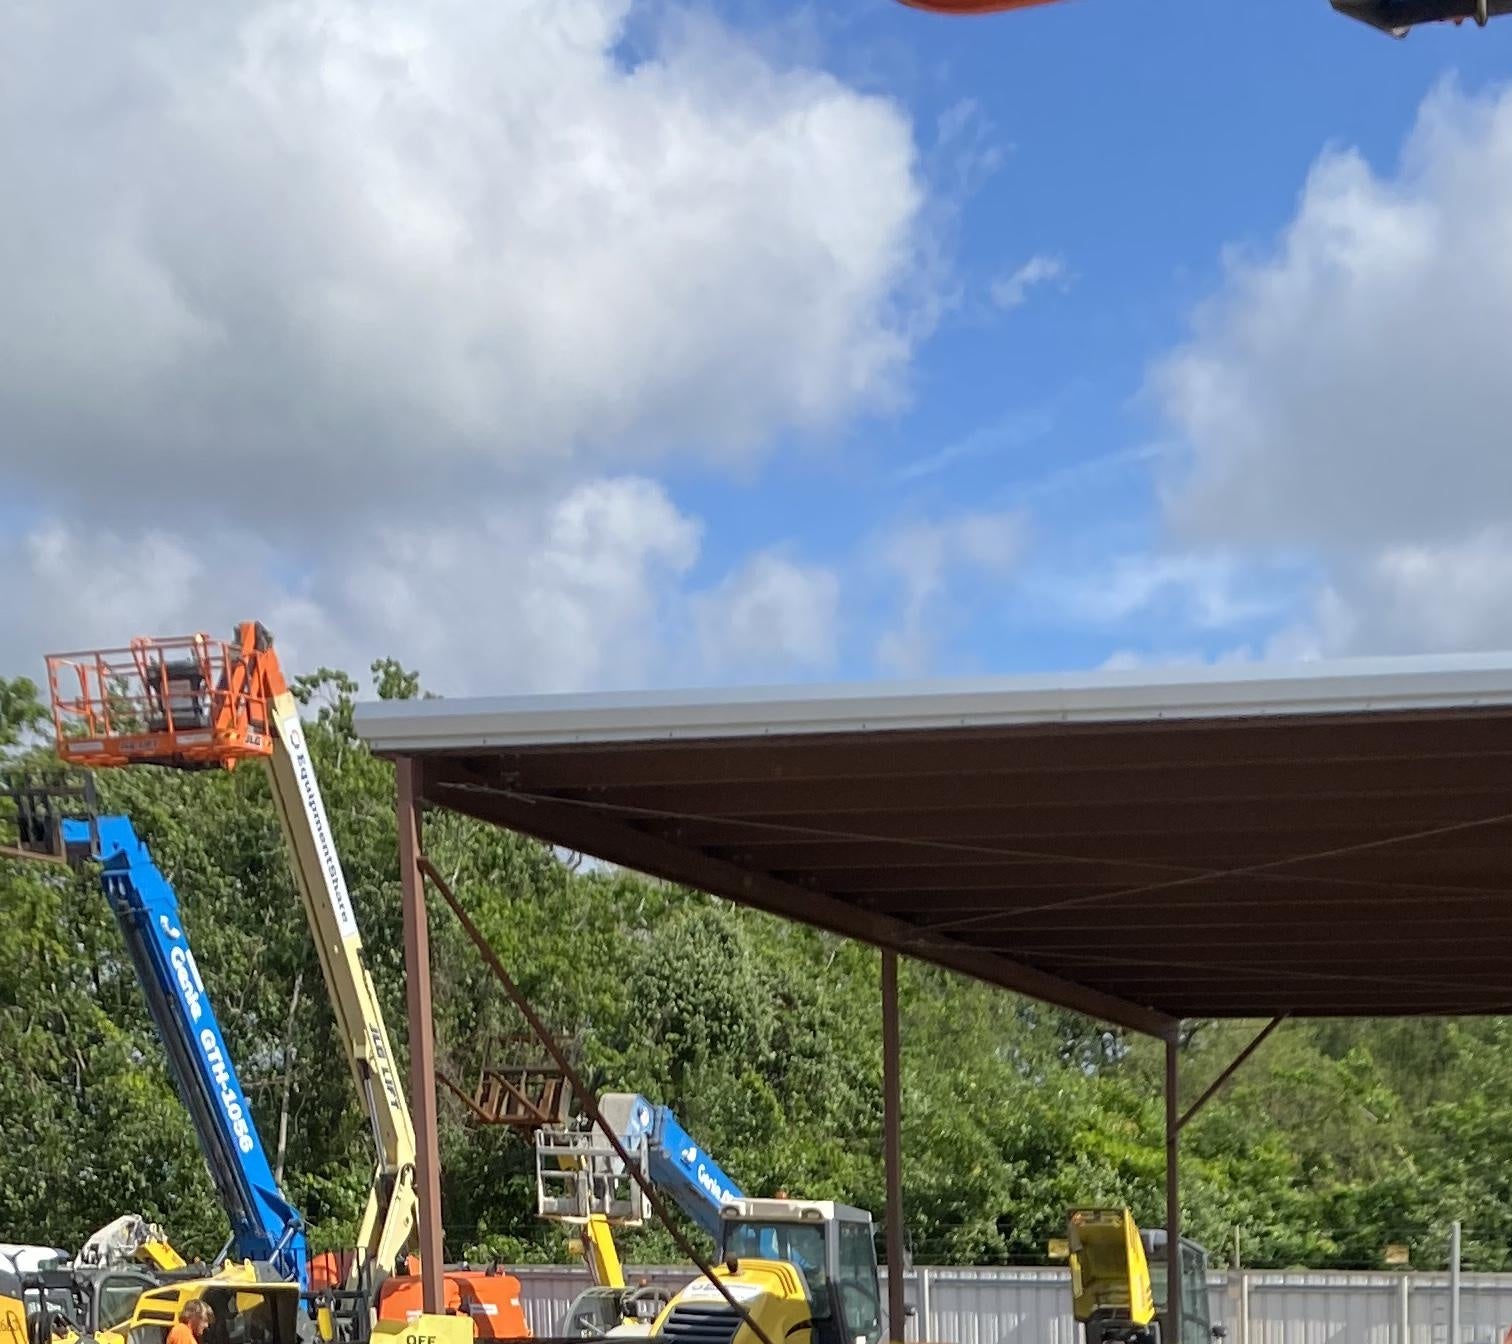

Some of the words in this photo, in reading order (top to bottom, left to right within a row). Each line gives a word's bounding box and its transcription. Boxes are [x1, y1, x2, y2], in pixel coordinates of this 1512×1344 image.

[297, 754, 348, 924] EquipmentShare
[170, 945, 202, 1024] Genie
[200, 1028, 254, 1154] GTH-1056
